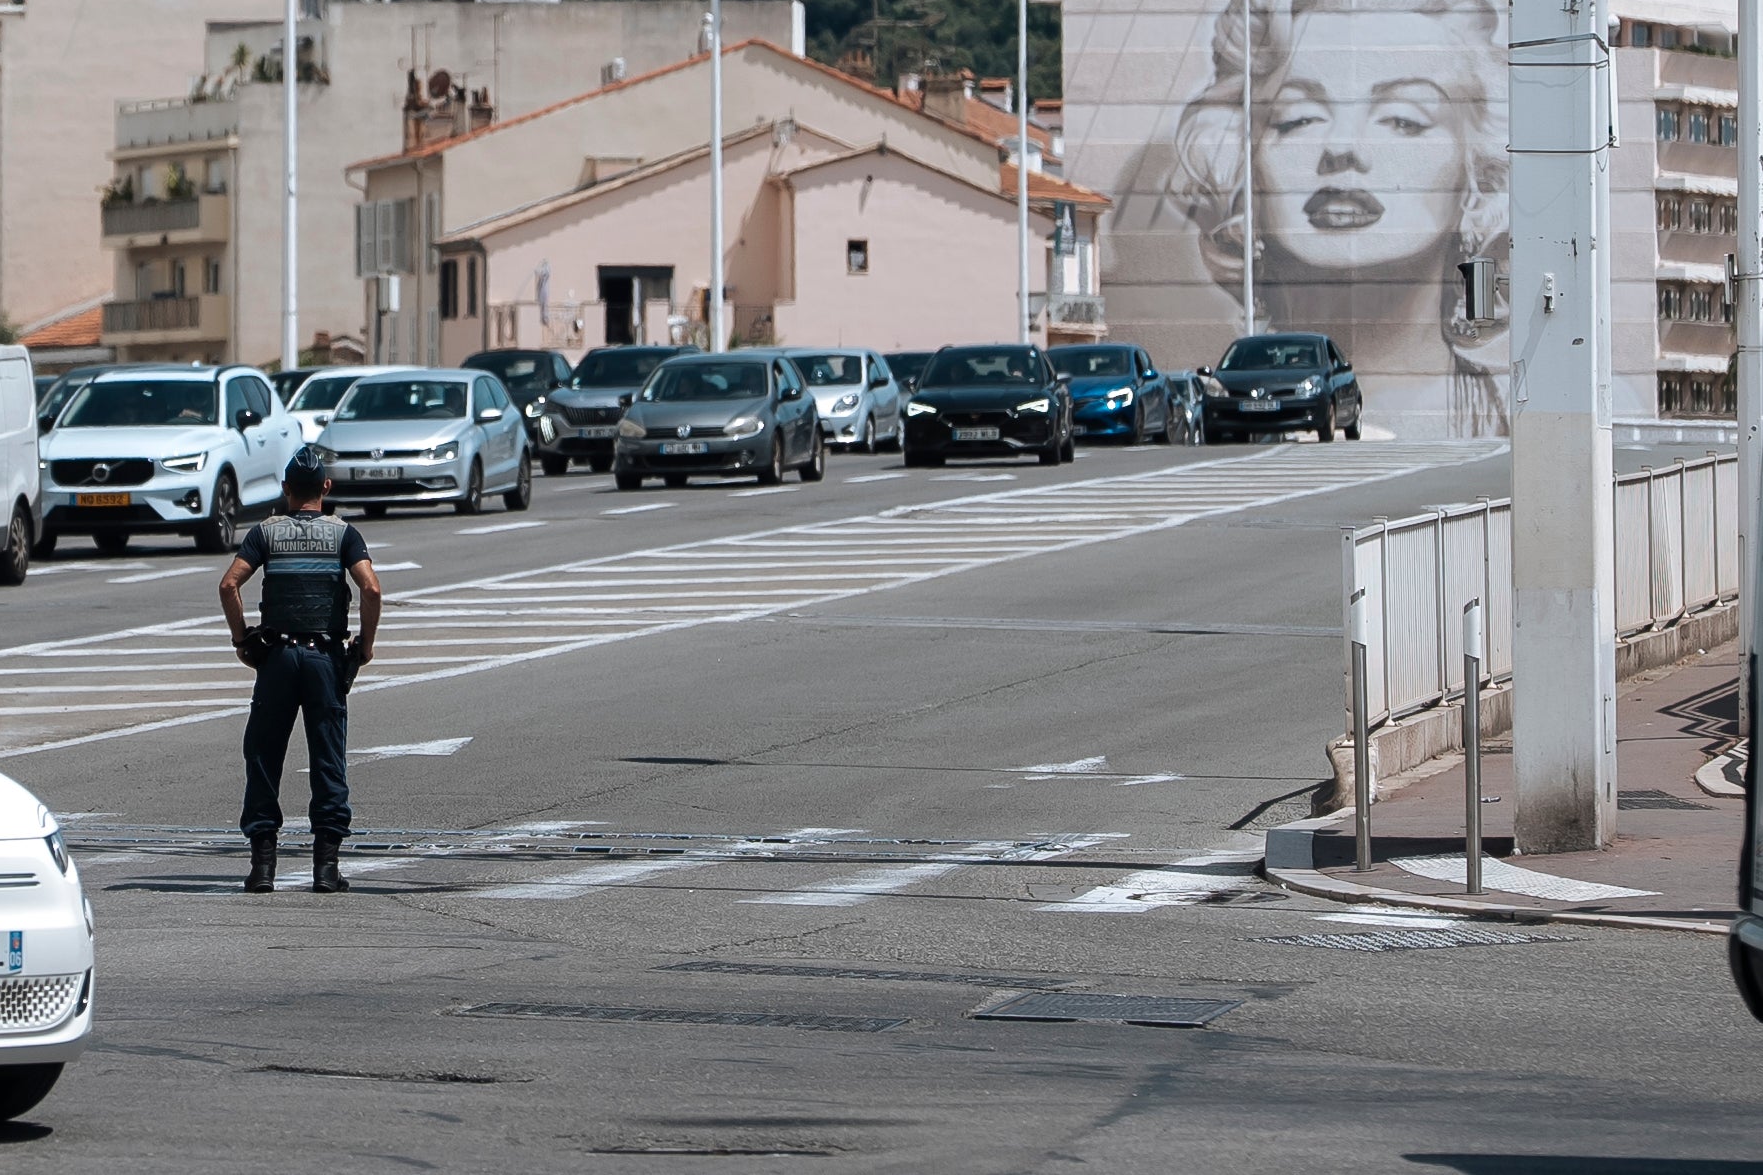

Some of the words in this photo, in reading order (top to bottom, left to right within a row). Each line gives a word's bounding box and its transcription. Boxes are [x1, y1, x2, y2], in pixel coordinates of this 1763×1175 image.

[273, 525, 334, 541] POLICE
[273, 541, 334, 552] MUNICIPALE
[9, 952, 21, 966] 06
